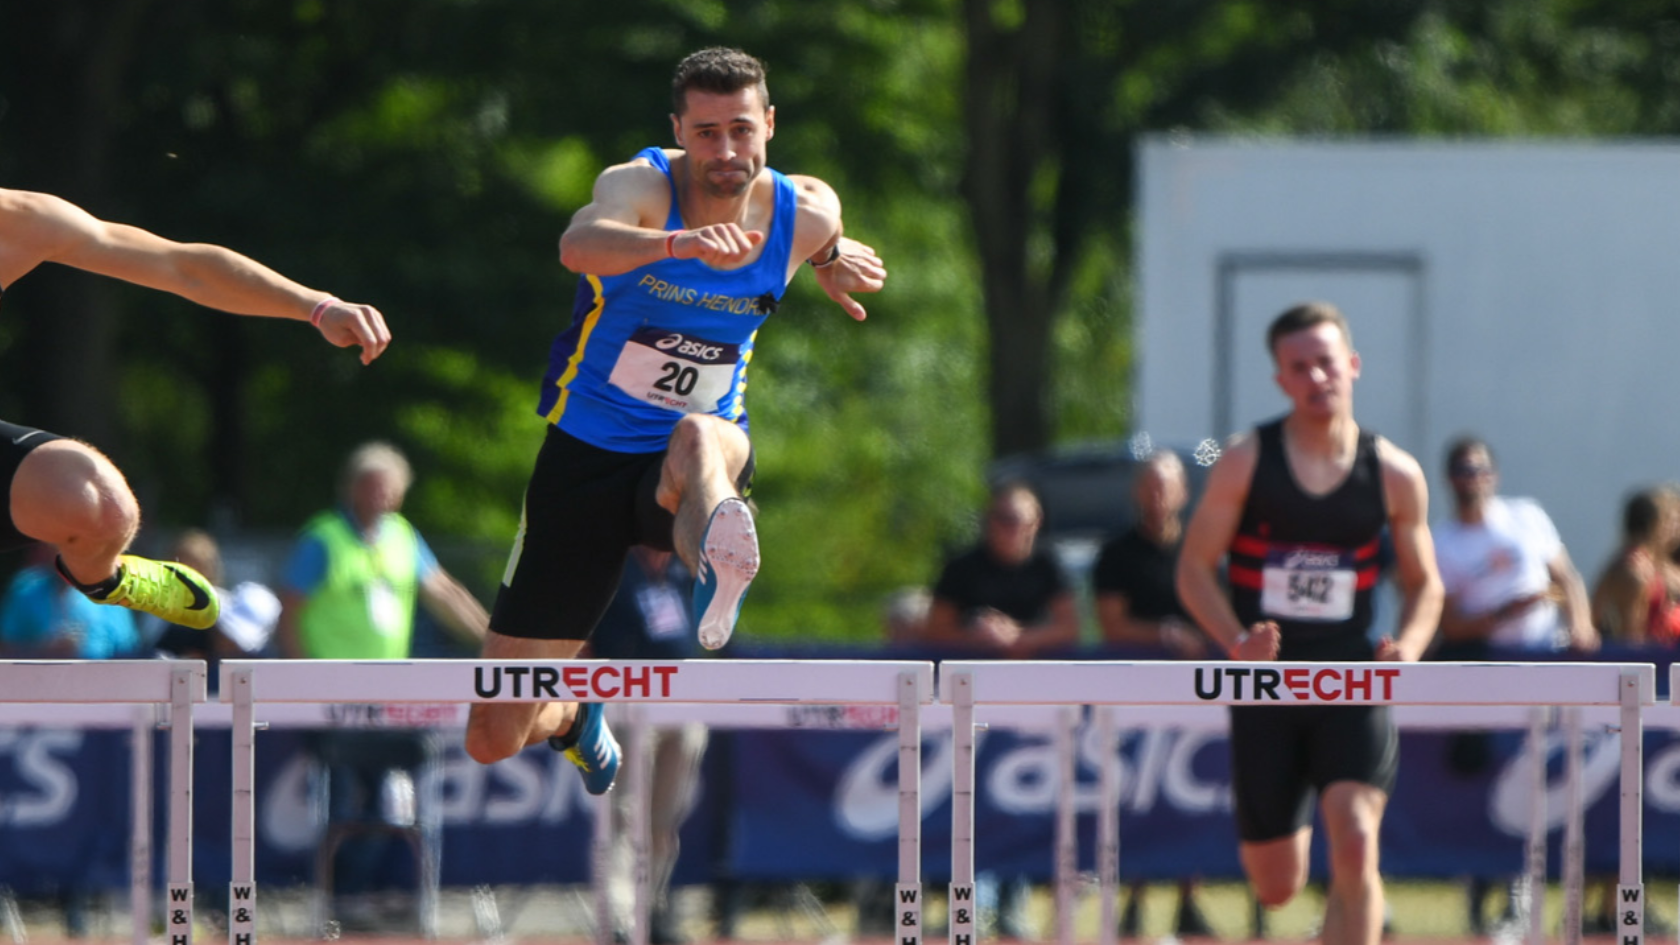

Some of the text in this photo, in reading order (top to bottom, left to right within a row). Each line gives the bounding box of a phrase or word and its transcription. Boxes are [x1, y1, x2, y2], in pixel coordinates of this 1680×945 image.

[639, 274, 770, 316] PRINS HENDR
[653, 361, 699, 396] 20
[647, 391, 688, 407] UTRECHT
[1288, 573, 1335, 604] 542
[474, 666, 678, 698] UTRECHT
[1195, 668, 1400, 700] UTRECHT
